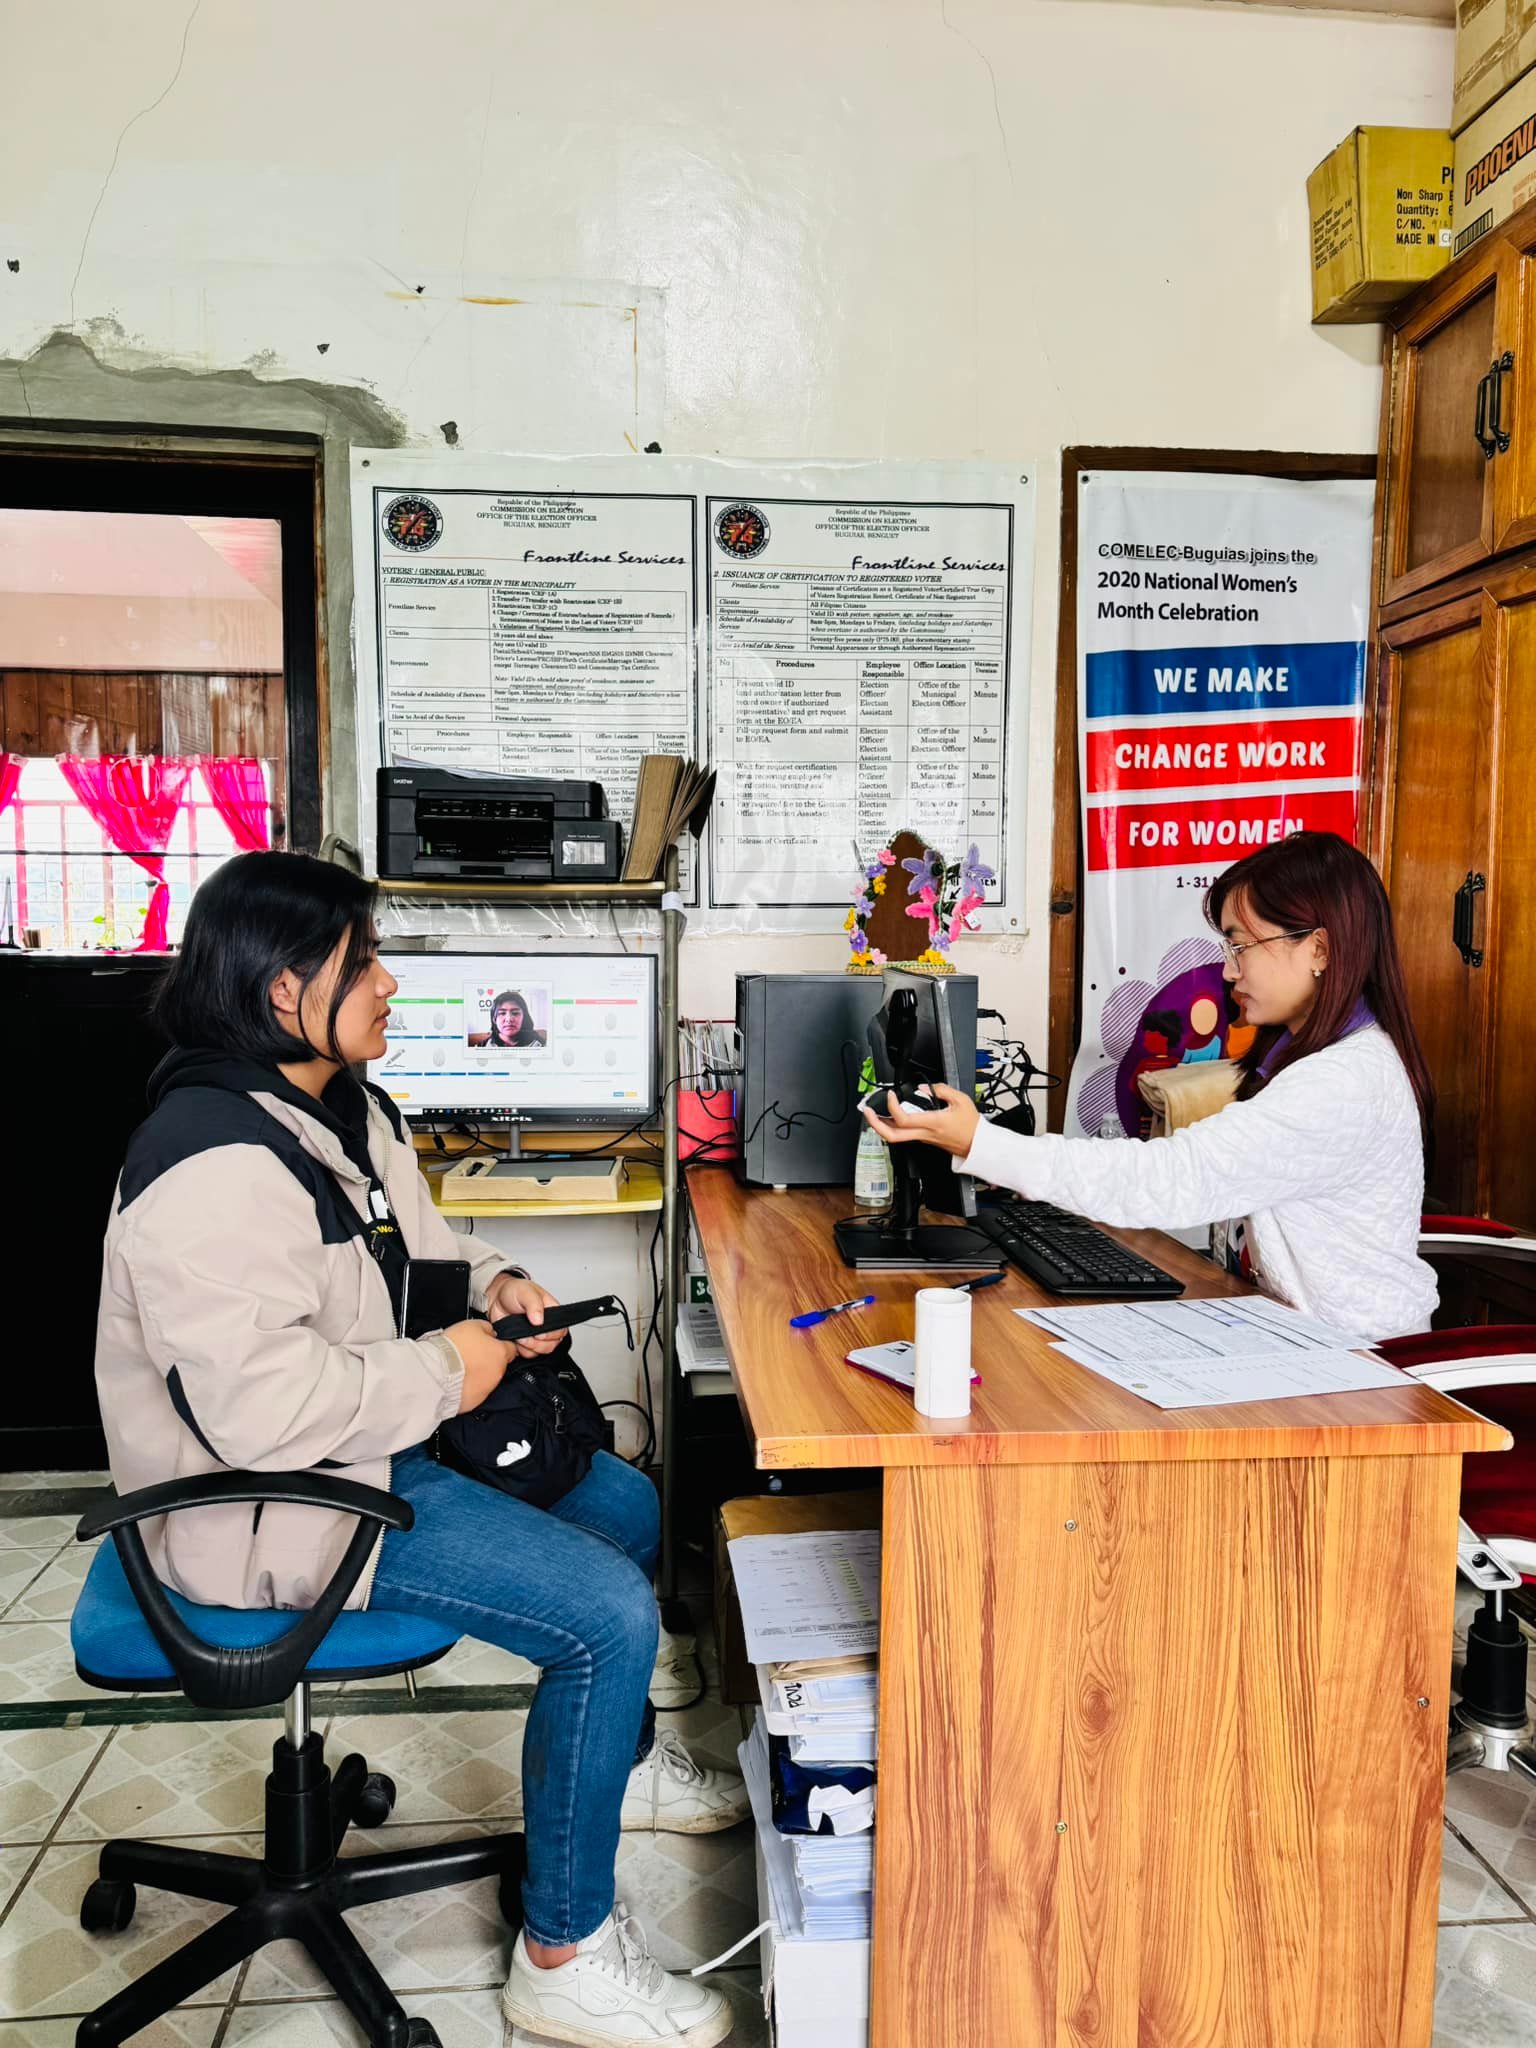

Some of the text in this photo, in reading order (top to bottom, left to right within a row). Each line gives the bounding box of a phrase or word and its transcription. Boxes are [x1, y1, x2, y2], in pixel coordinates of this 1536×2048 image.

[1464, 113, 1536, 207] PHOENI
[1396, 188, 1412, 201] Non
[1419, 189, 1443, 202] Sharp
[1396, 203, 1439, 217] Quantity:
[1396, 218, 1425, 230] C/NO.
[1396, 233, 1421, 245] MADE
[1427, 234, 1436, 245] IN
[523, 550, 688, 564] Frontline Services
[1097, 543, 1316, 565] COMELEC-Buguias joins the
[851, 555, 1007, 572] Frontline Services
[1097, 571, 1140, 588] 2020
[1144, 572, 1219, 590] National
[1097, 601, 1258, 621] Month Celebration
[775, 660, 815, 668] Procedures
[865, 661, 901, 670] Employee
[913, 661, 967, 669] Office Location
[860, 681, 889, 689] Election
[917, 681, 938, 689] Office
[1153, 666, 1289, 693] WE MAKE
[921, 691, 957, 699] Municipal
[942, 700, 967, 708] Officer
[762, 728, 788, 736] request
[824, 727, 849, 735] submit
[859, 727, 889, 735] Election
[941, 745, 967, 753] Officer
[1115, 741, 1327, 769] CHANGE WORK
[794, 763, 838, 771] certification
[1128, 818, 1304, 847] FOR WOMEN
[1193, 876, 1209, 888] 31
